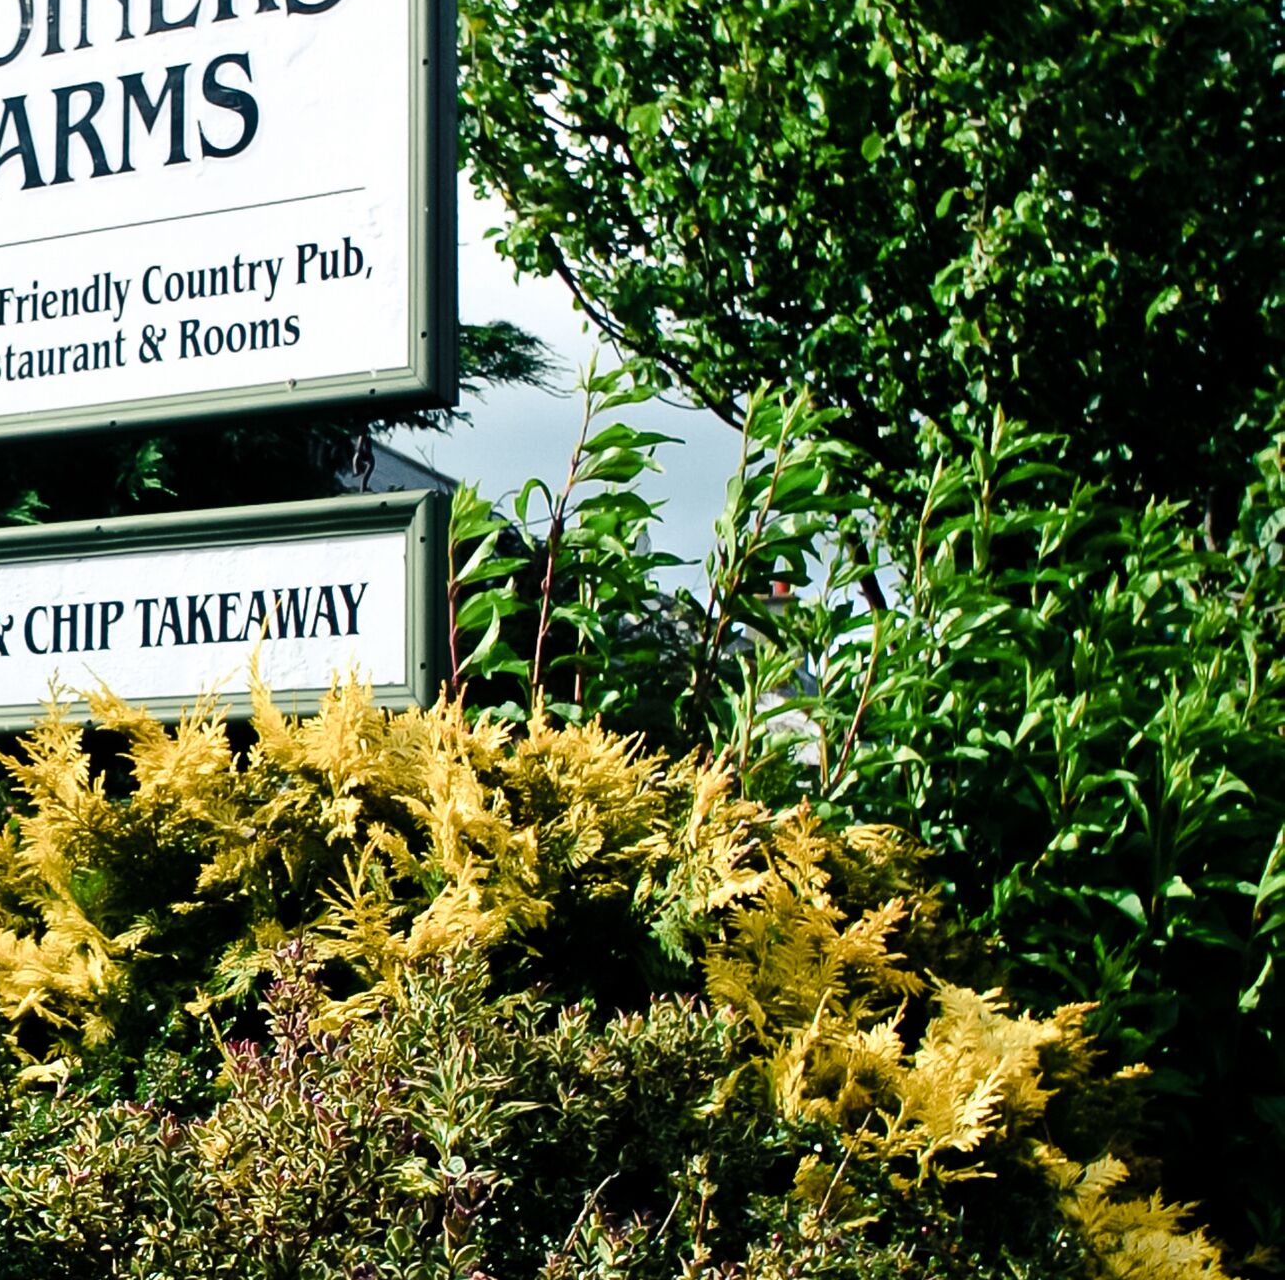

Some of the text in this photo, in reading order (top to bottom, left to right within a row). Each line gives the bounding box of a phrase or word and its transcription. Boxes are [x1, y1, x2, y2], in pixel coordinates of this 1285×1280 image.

[142, 251, 285, 306] Country
[295, 236, 374, 286] Pub,
[138, 324, 167, 364] &
[178, 314, 301, 360] Rooms
[23, 599, 126, 656] CHIP
[133, 581, 370, 649] TAKEAWAY
